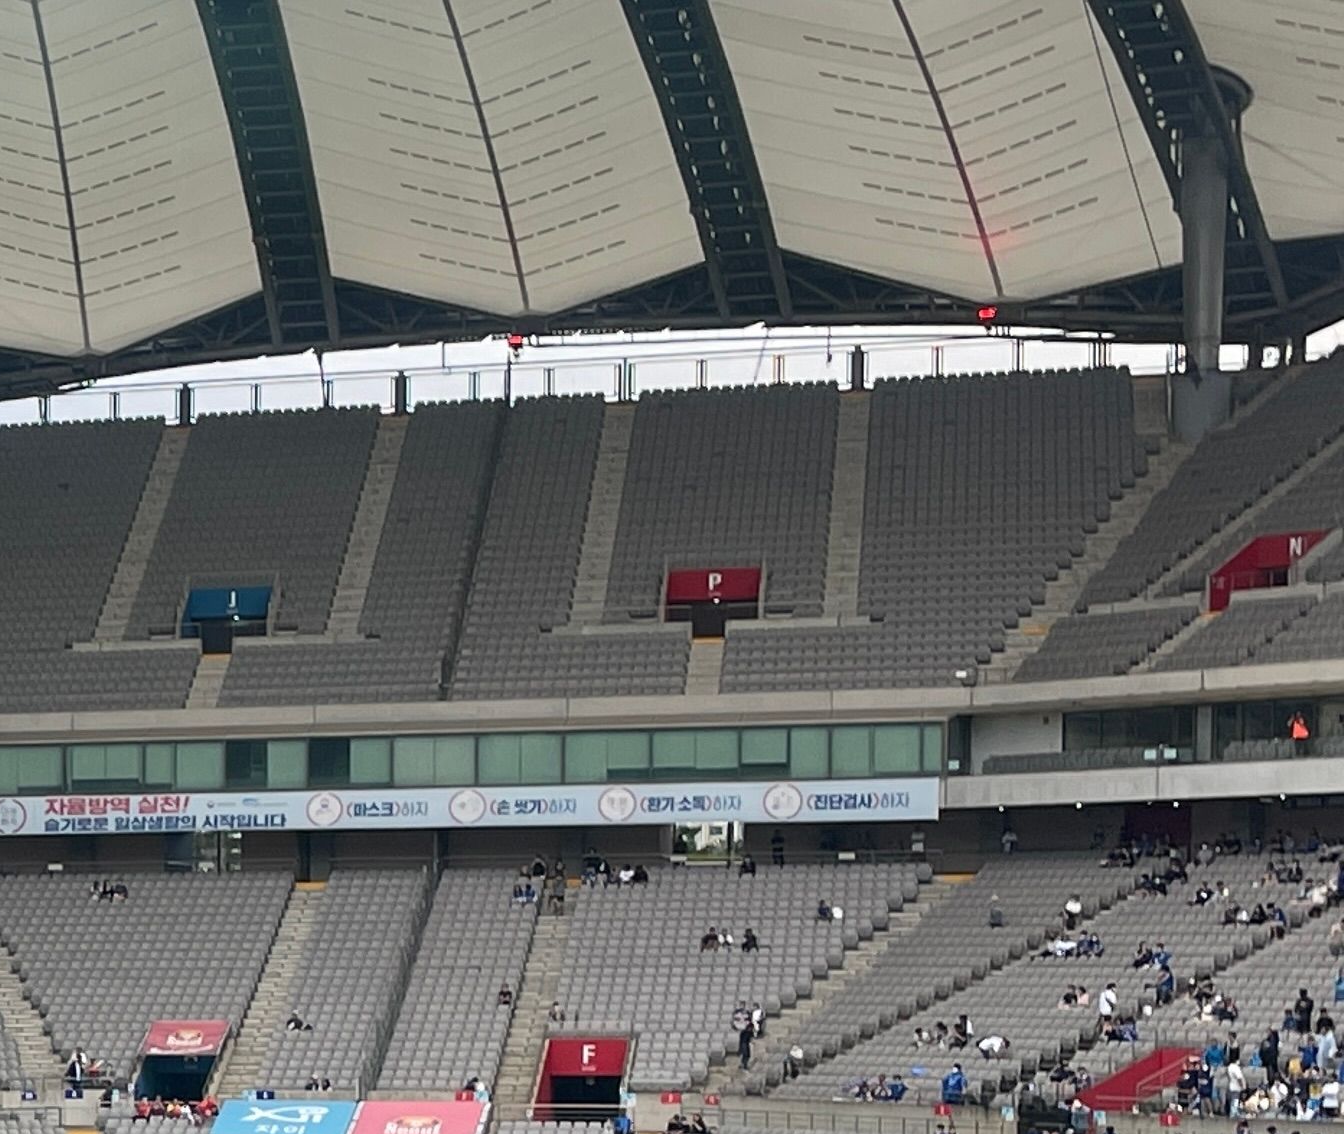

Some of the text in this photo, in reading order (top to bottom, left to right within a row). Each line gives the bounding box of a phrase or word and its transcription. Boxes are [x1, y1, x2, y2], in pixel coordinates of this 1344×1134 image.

[1290, 536, 1302, 556] N
[708, 572, 722, 591] P
[582, 1044, 596, 1064] F
